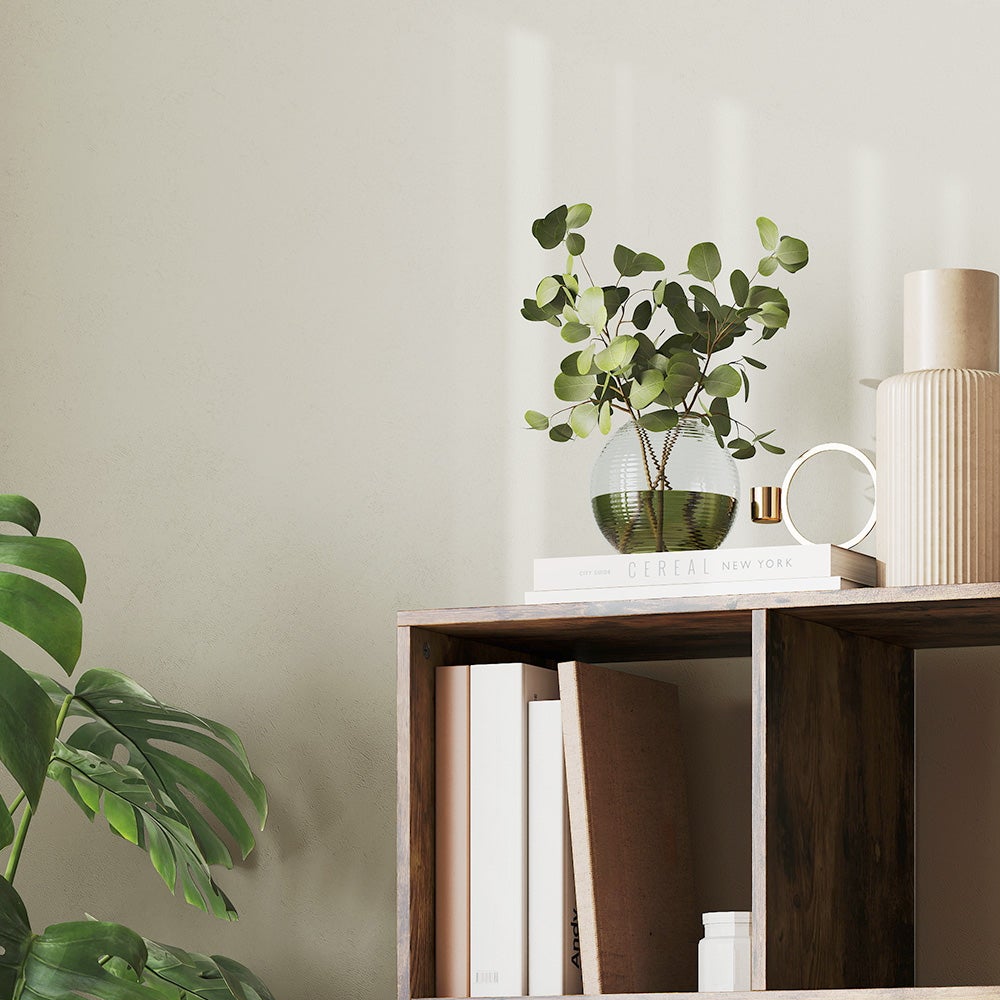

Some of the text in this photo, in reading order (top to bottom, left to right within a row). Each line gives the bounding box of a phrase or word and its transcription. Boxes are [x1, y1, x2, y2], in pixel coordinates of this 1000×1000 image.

[628, 557, 710, 579] CEREAL
[721, 557, 793, 571] NEW YORK
